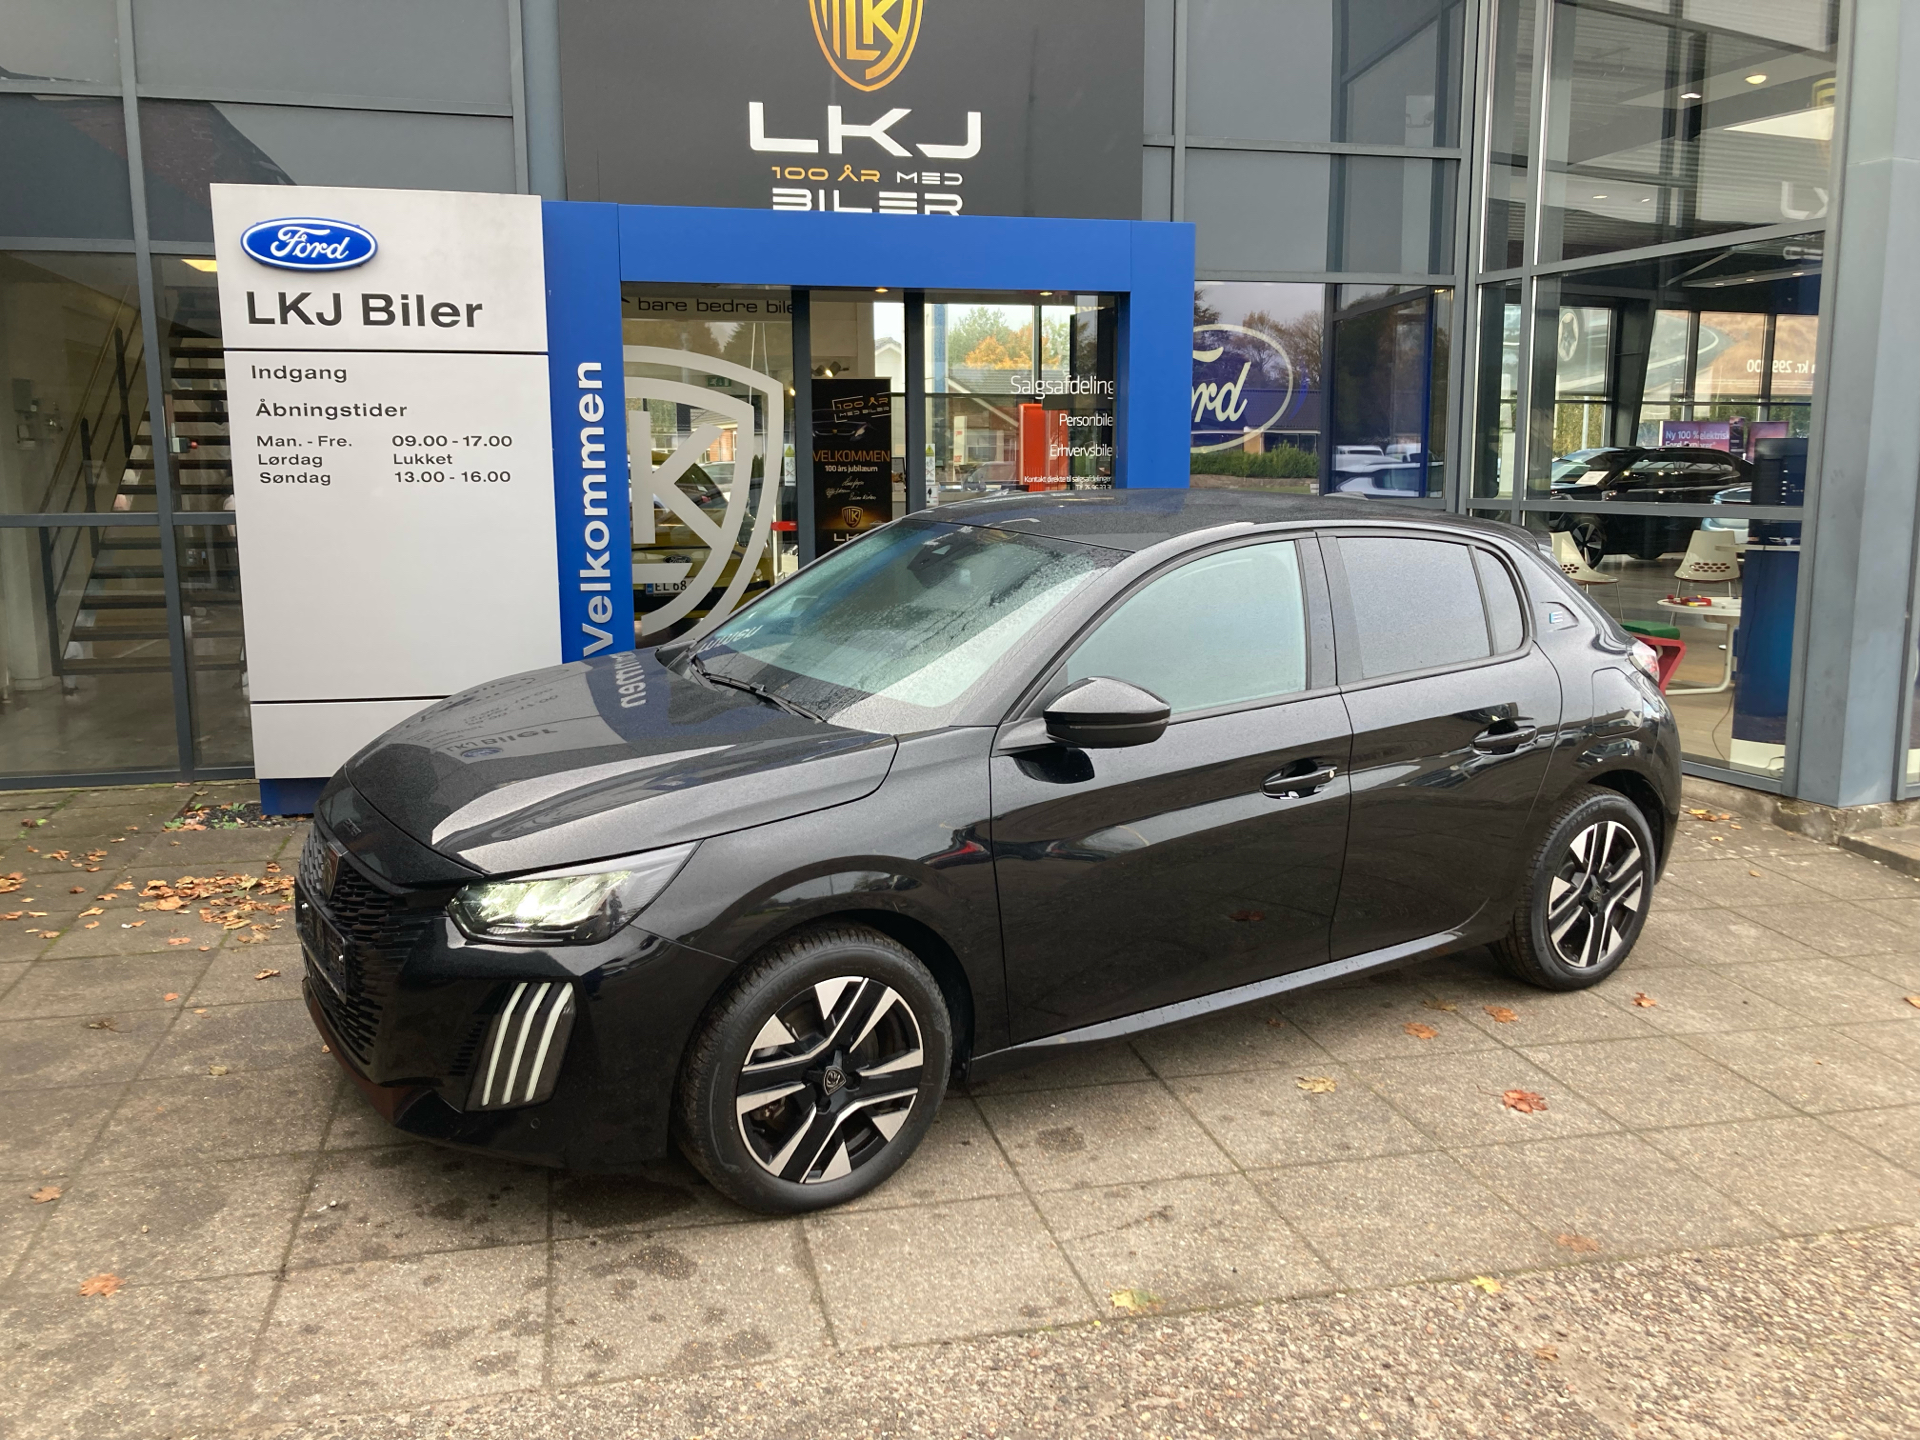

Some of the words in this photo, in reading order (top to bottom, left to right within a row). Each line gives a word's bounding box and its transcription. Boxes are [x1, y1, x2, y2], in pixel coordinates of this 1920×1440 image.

[749, 101, 981, 159] LKJ
[772, 166, 829, 181] 100
[838, 164, 880, 182] ÅR
[897, 171, 963, 185] MED
[772, 188, 963, 216] BILER
[270, 226, 350, 259] Ford
[246, 291, 342, 326] LKJ
[361, 293, 483, 327] Biler
[638, 297, 687, 311] bare
[696, 299, 758, 313] bedre
[251, 365, 347, 383] Indgang
[1010, 375, 1114, 399] Salgsafdeling
[255, 398, 407, 420] Åbningstider
[257, 436, 302, 447] Man.
[318, 436, 352, 447] Fre.
[1665, 431, 1675, 440] Ny
[1678, 431, 1691, 439] 100
[258, 454, 323, 467] Lørdag
[393, 453, 452, 465] Lukket
[812, 450, 890, 462] VELKOMMEN
[259, 472, 331, 486] Søndag
[394, 471, 445, 483] 13.00
[461, 471, 511, 483] 16.00
[577, 362, 614, 657] Velkommen
